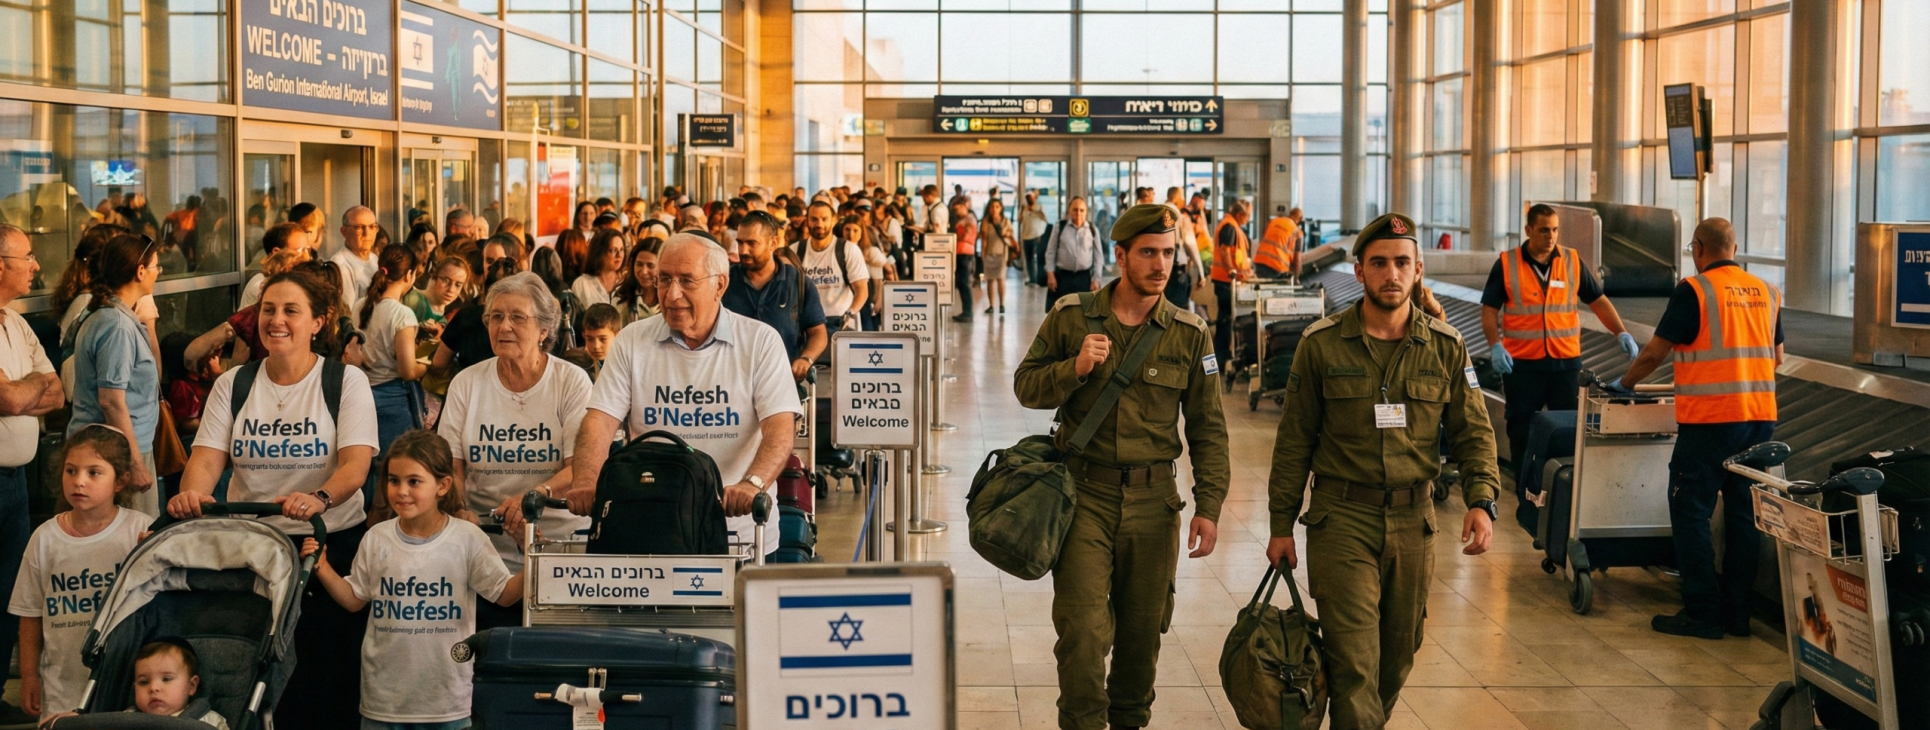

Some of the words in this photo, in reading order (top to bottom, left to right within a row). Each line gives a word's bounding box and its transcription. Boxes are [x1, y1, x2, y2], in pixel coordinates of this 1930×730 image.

[323, 0, 367, 36] ברוכים
[246, 24, 322, 66] WELCOME
[246, 68, 264, 90] Ben
[266, 71, 295, 95] Gurion
[296, 76, 343, 101] International
[370, 86, 388, 106] Israel
[892, 312, 928, 321] ברוכים
[892, 323, 927, 332] הבאים
[655, 384, 729, 405] Nefesh
[850, 382, 902, 394] ברוכים
[242, 417, 317, 436] Nefesh
[644, 406, 740, 427] B'Nefesh
[842, 415, 909, 428] Welcome
[479, 422, 551, 442] Nefesh
[232, 437, 329, 458] B'Nefesh
[469, 443, 560, 463] B'Nefesh
[553, 566, 605, 579] הבאים
[611, 567, 666, 579] ברוכים
[380, 576, 453, 597] Nefesh
[568, 582, 650, 598] Welcome
[46, 590, 102, 617] B'Nef
[372, 599, 462, 620] B'Nefesh
[786, 693, 910, 720] ברוכים
